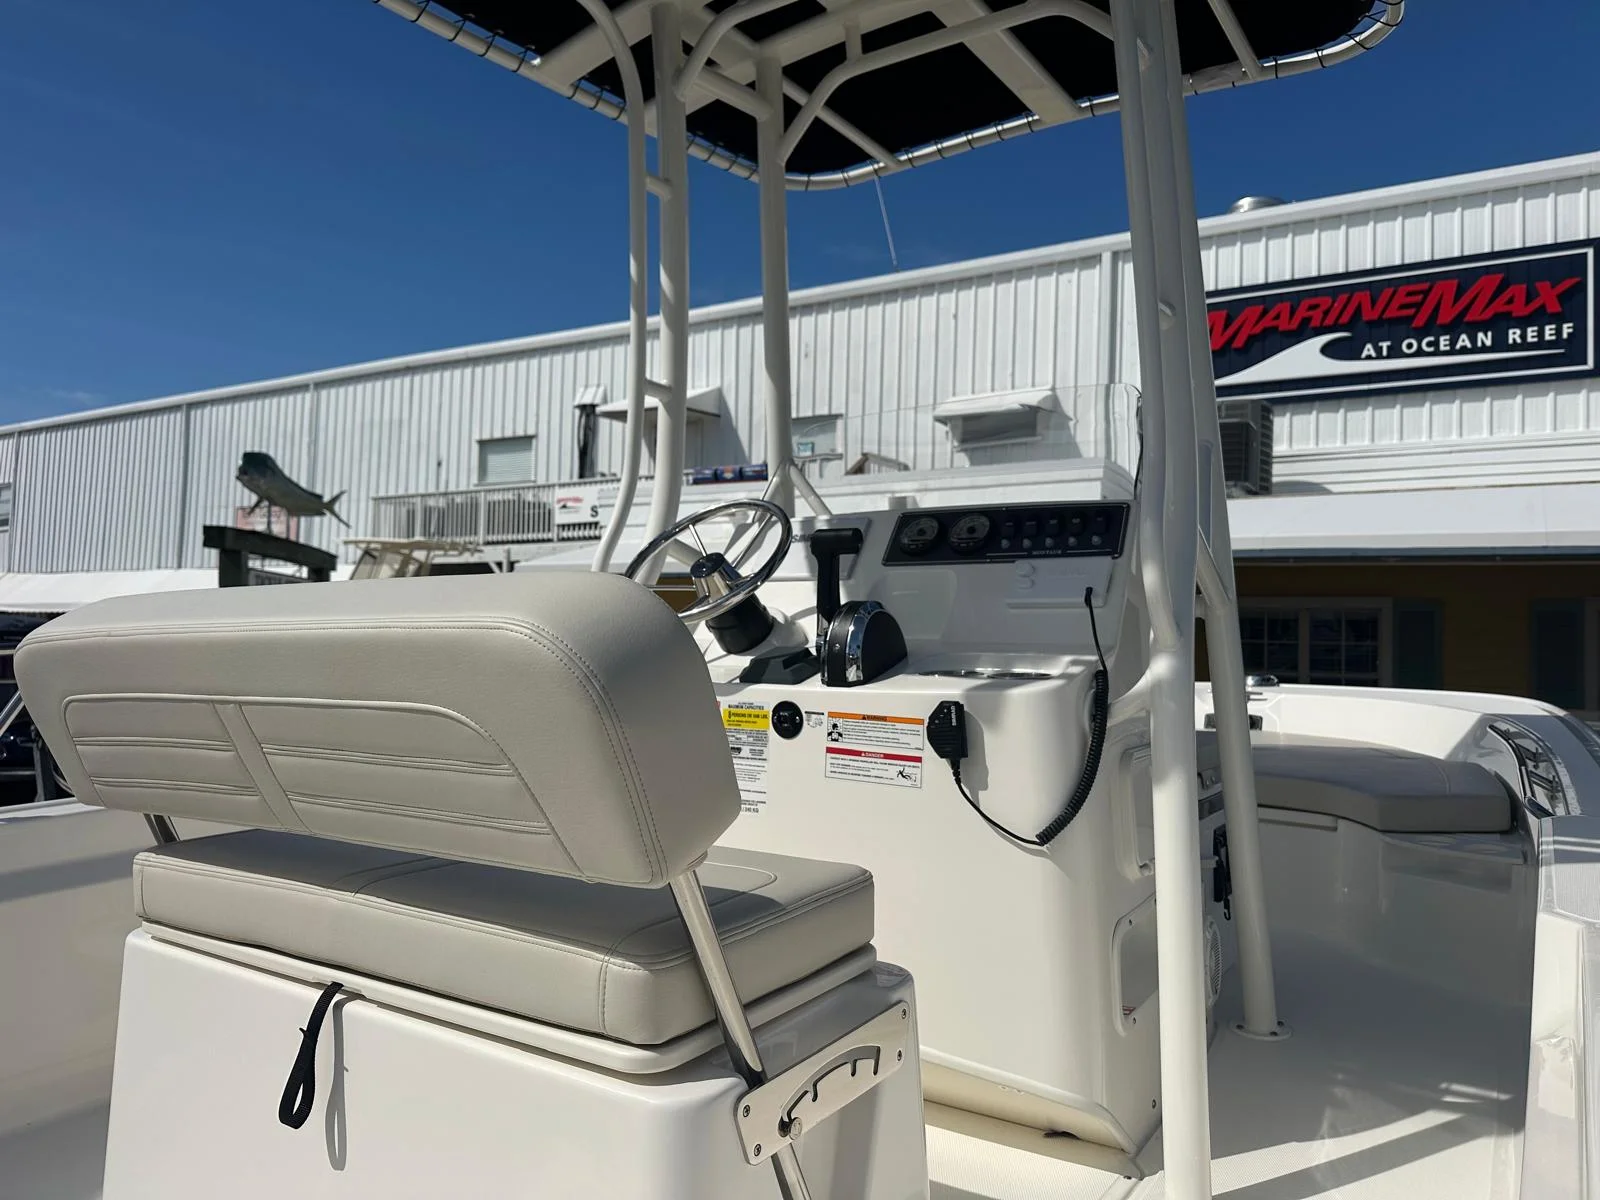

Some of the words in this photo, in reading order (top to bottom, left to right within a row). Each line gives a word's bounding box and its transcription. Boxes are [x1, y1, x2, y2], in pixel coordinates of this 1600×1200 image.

[1207, 274, 1583, 351] MARINEMAX
[1361, 340, 1392, 359] AT
[1401, 331, 1493, 355] OCEAN
[1508, 322, 1575, 345] REEF
